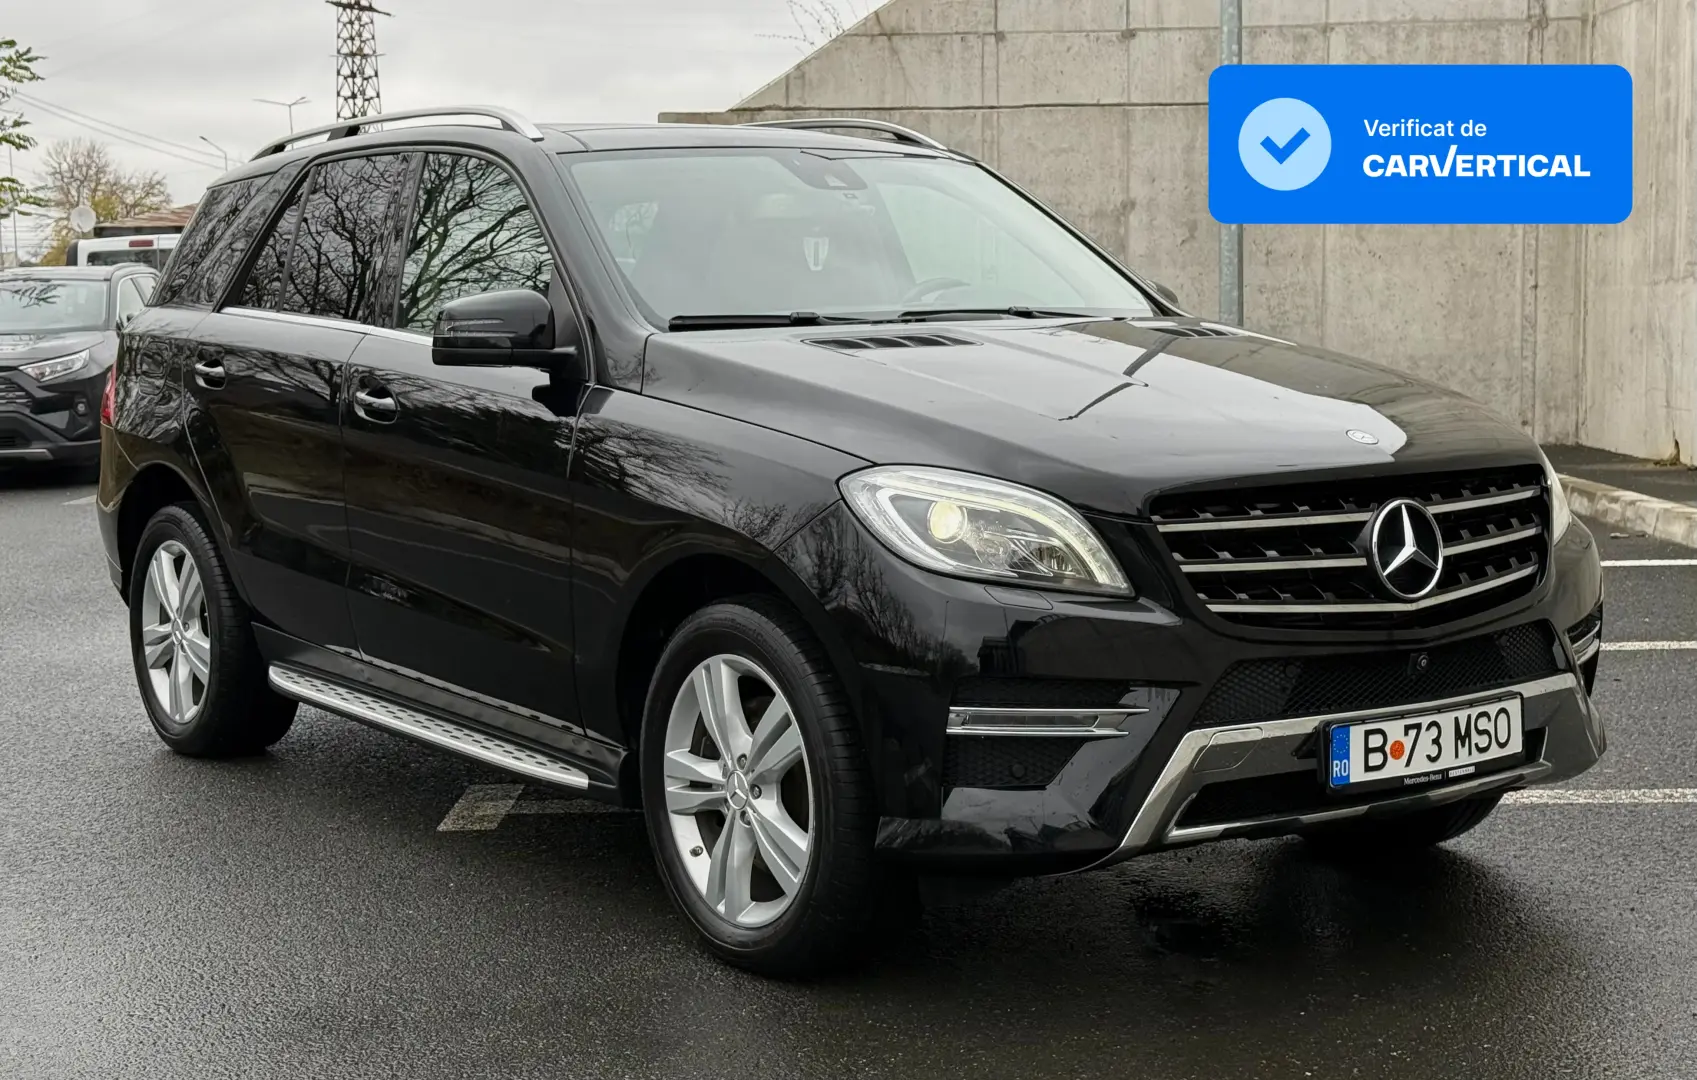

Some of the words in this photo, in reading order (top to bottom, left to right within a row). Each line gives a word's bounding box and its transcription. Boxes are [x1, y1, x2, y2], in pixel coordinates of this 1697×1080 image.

[1363, 727, 1389, 773] B
[1403, 719, 1443, 768] 73
[1453, 706, 1512, 759] MSO
[1333, 759, 1349, 777] RO
